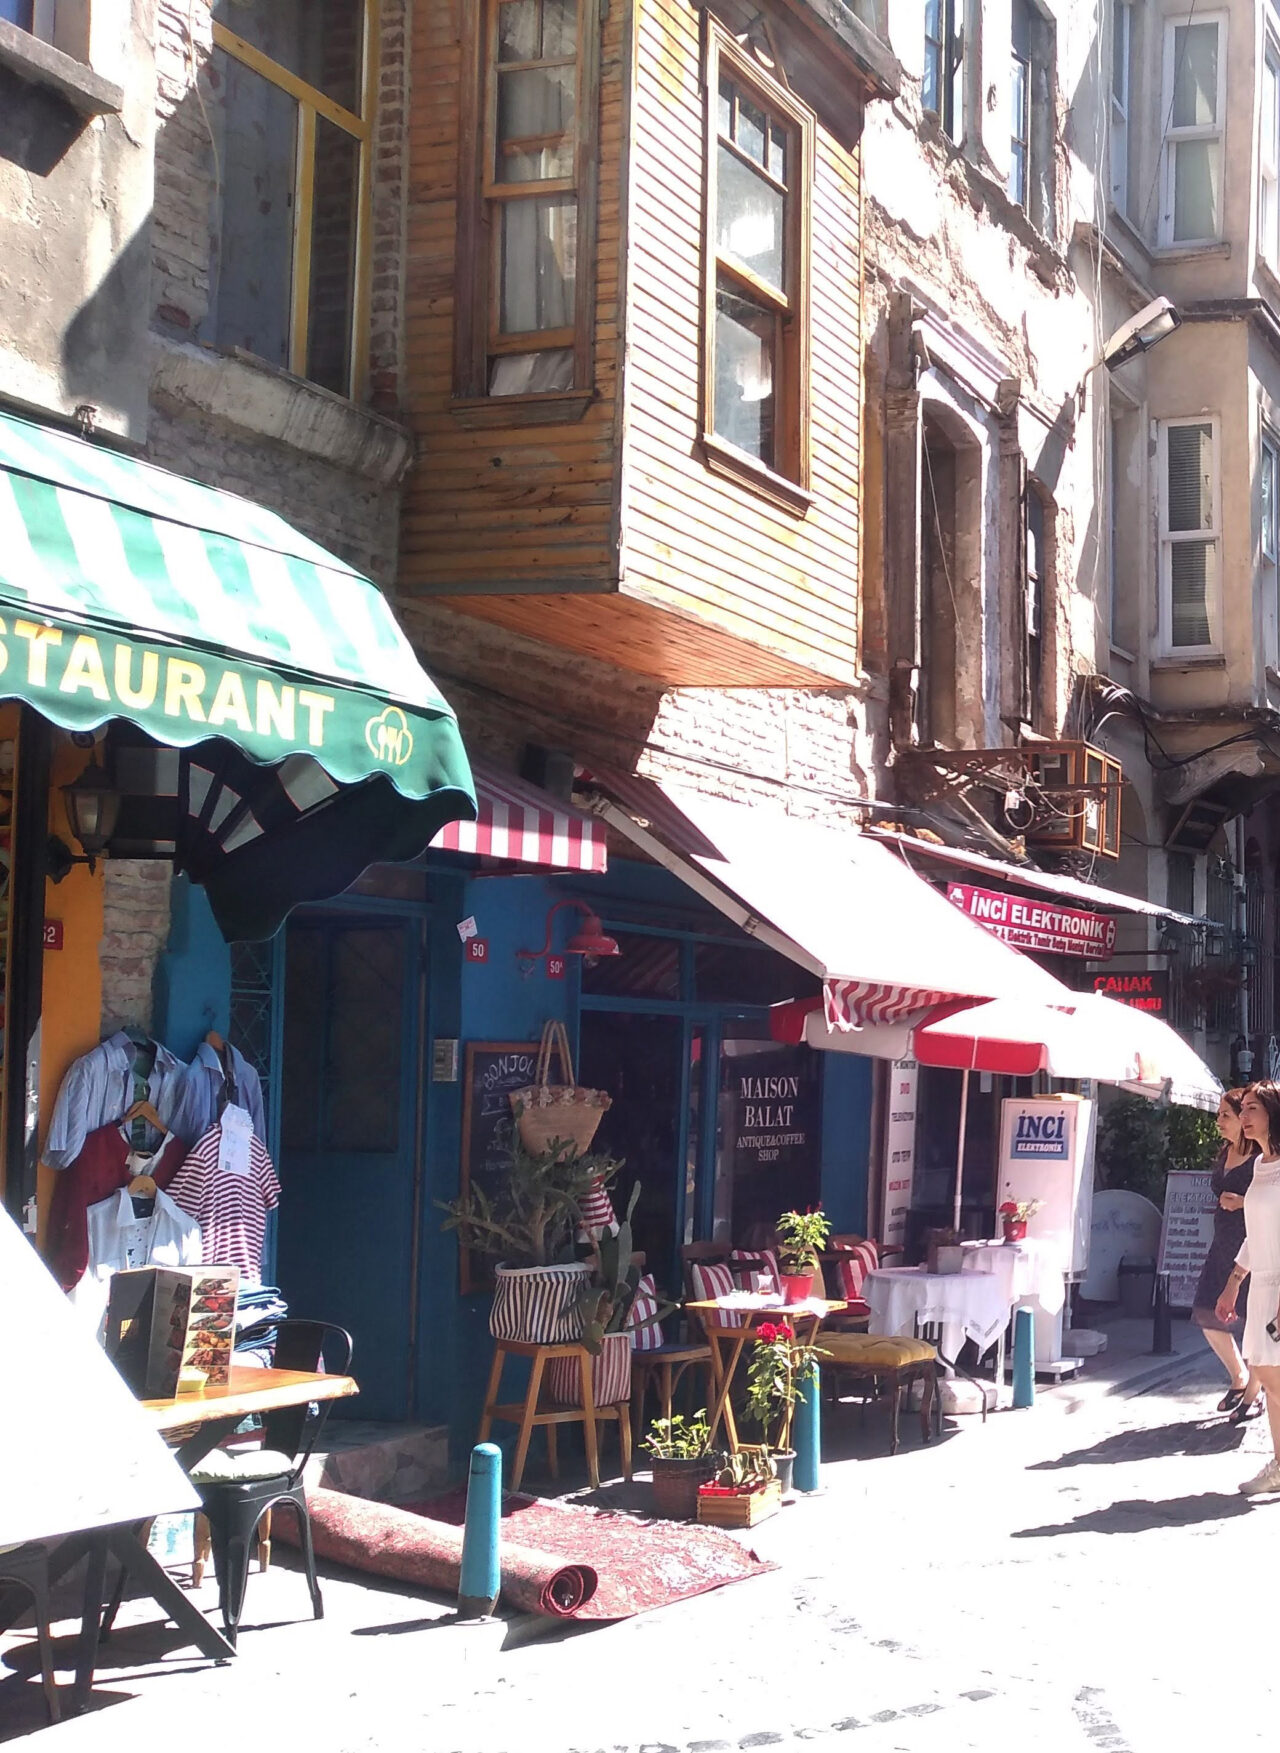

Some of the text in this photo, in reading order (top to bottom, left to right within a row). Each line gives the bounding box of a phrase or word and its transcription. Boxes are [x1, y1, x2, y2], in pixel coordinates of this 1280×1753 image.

[0, 616, 335, 747] TAURANT
[970, 891, 1105, 939] İNCİ ELEKTRONİK
[472, 943, 484, 957] 50
[740, 1076, 799, 1099] MAISON
[744, 1105, 794, 1127] BALAT
[1016, 1109, 1066, 1139] İNCİ
[758, 1149, 779, 1161] SHOP
[1017, 1142, 1063, 1153] ELEKTRONİK
[1169, 1191, 1218, 1202] ELEKTRON
